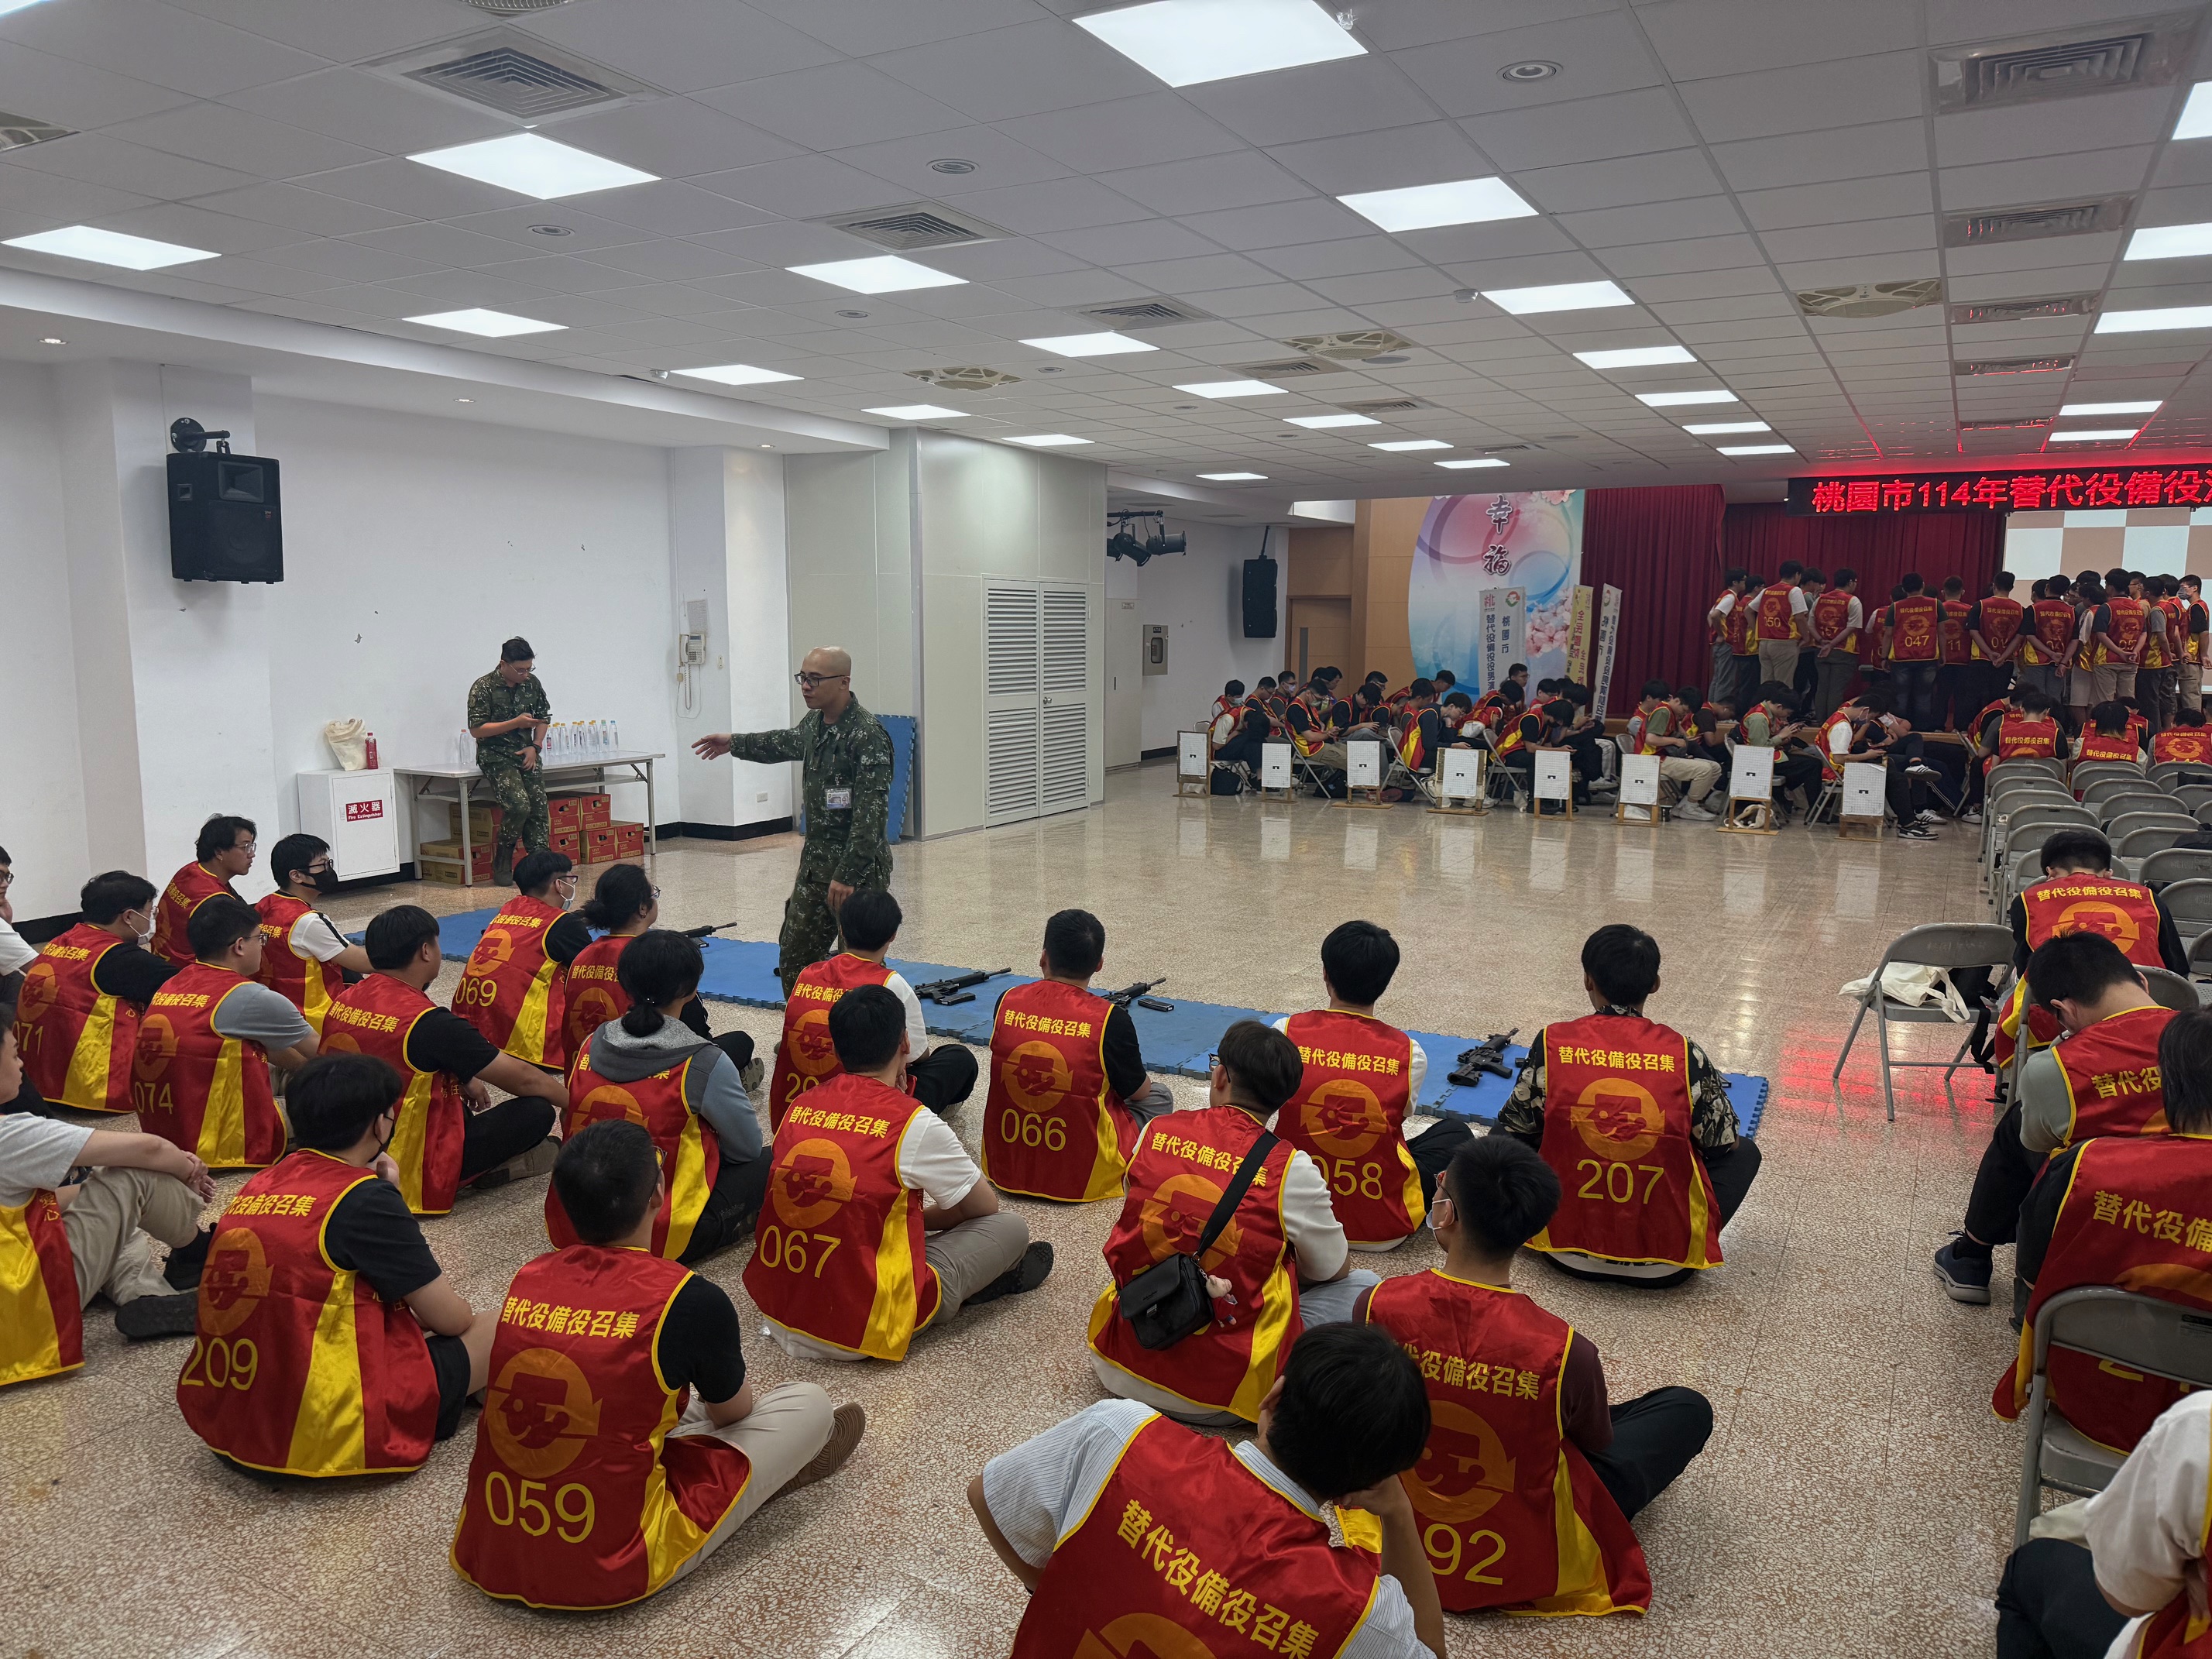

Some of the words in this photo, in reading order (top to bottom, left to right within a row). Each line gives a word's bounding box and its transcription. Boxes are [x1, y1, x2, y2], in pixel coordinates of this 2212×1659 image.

[1905, 634, 1930, 647] 047
[348, 801, 381, 815] 滅火器
[2036, 885, 2143, 902] 替代役備役召集
[455, 977, 498, 1007] 069
[794, 983, 850, 1003] 替代役備役
[328, 1000, 400, 1033] 替代役備役召集
[1004, 1008, 1093, 1039] 替代役備役召集
[1297, 1045, 1401, 1077] 替代役備役召集
[1558, 1046, 1675, 1073] 替代役備役召集
[134, 1080, 173, 1115] 074
[788, 1105, 891, 1139] 替代役備役召集
[1001, 1108, 1067, 1152] 066
[1576, 1159, 1664, 1205] 207
[759, 1224, 842, 1279] 067
[500, 1296, 641, 1340] 替代役備役召集
[180, 1334, 259, 1391] 209
[485, 1471, 596, 1544] 059
[1116, 1498, 1321, 1659] 替代役備役召集
